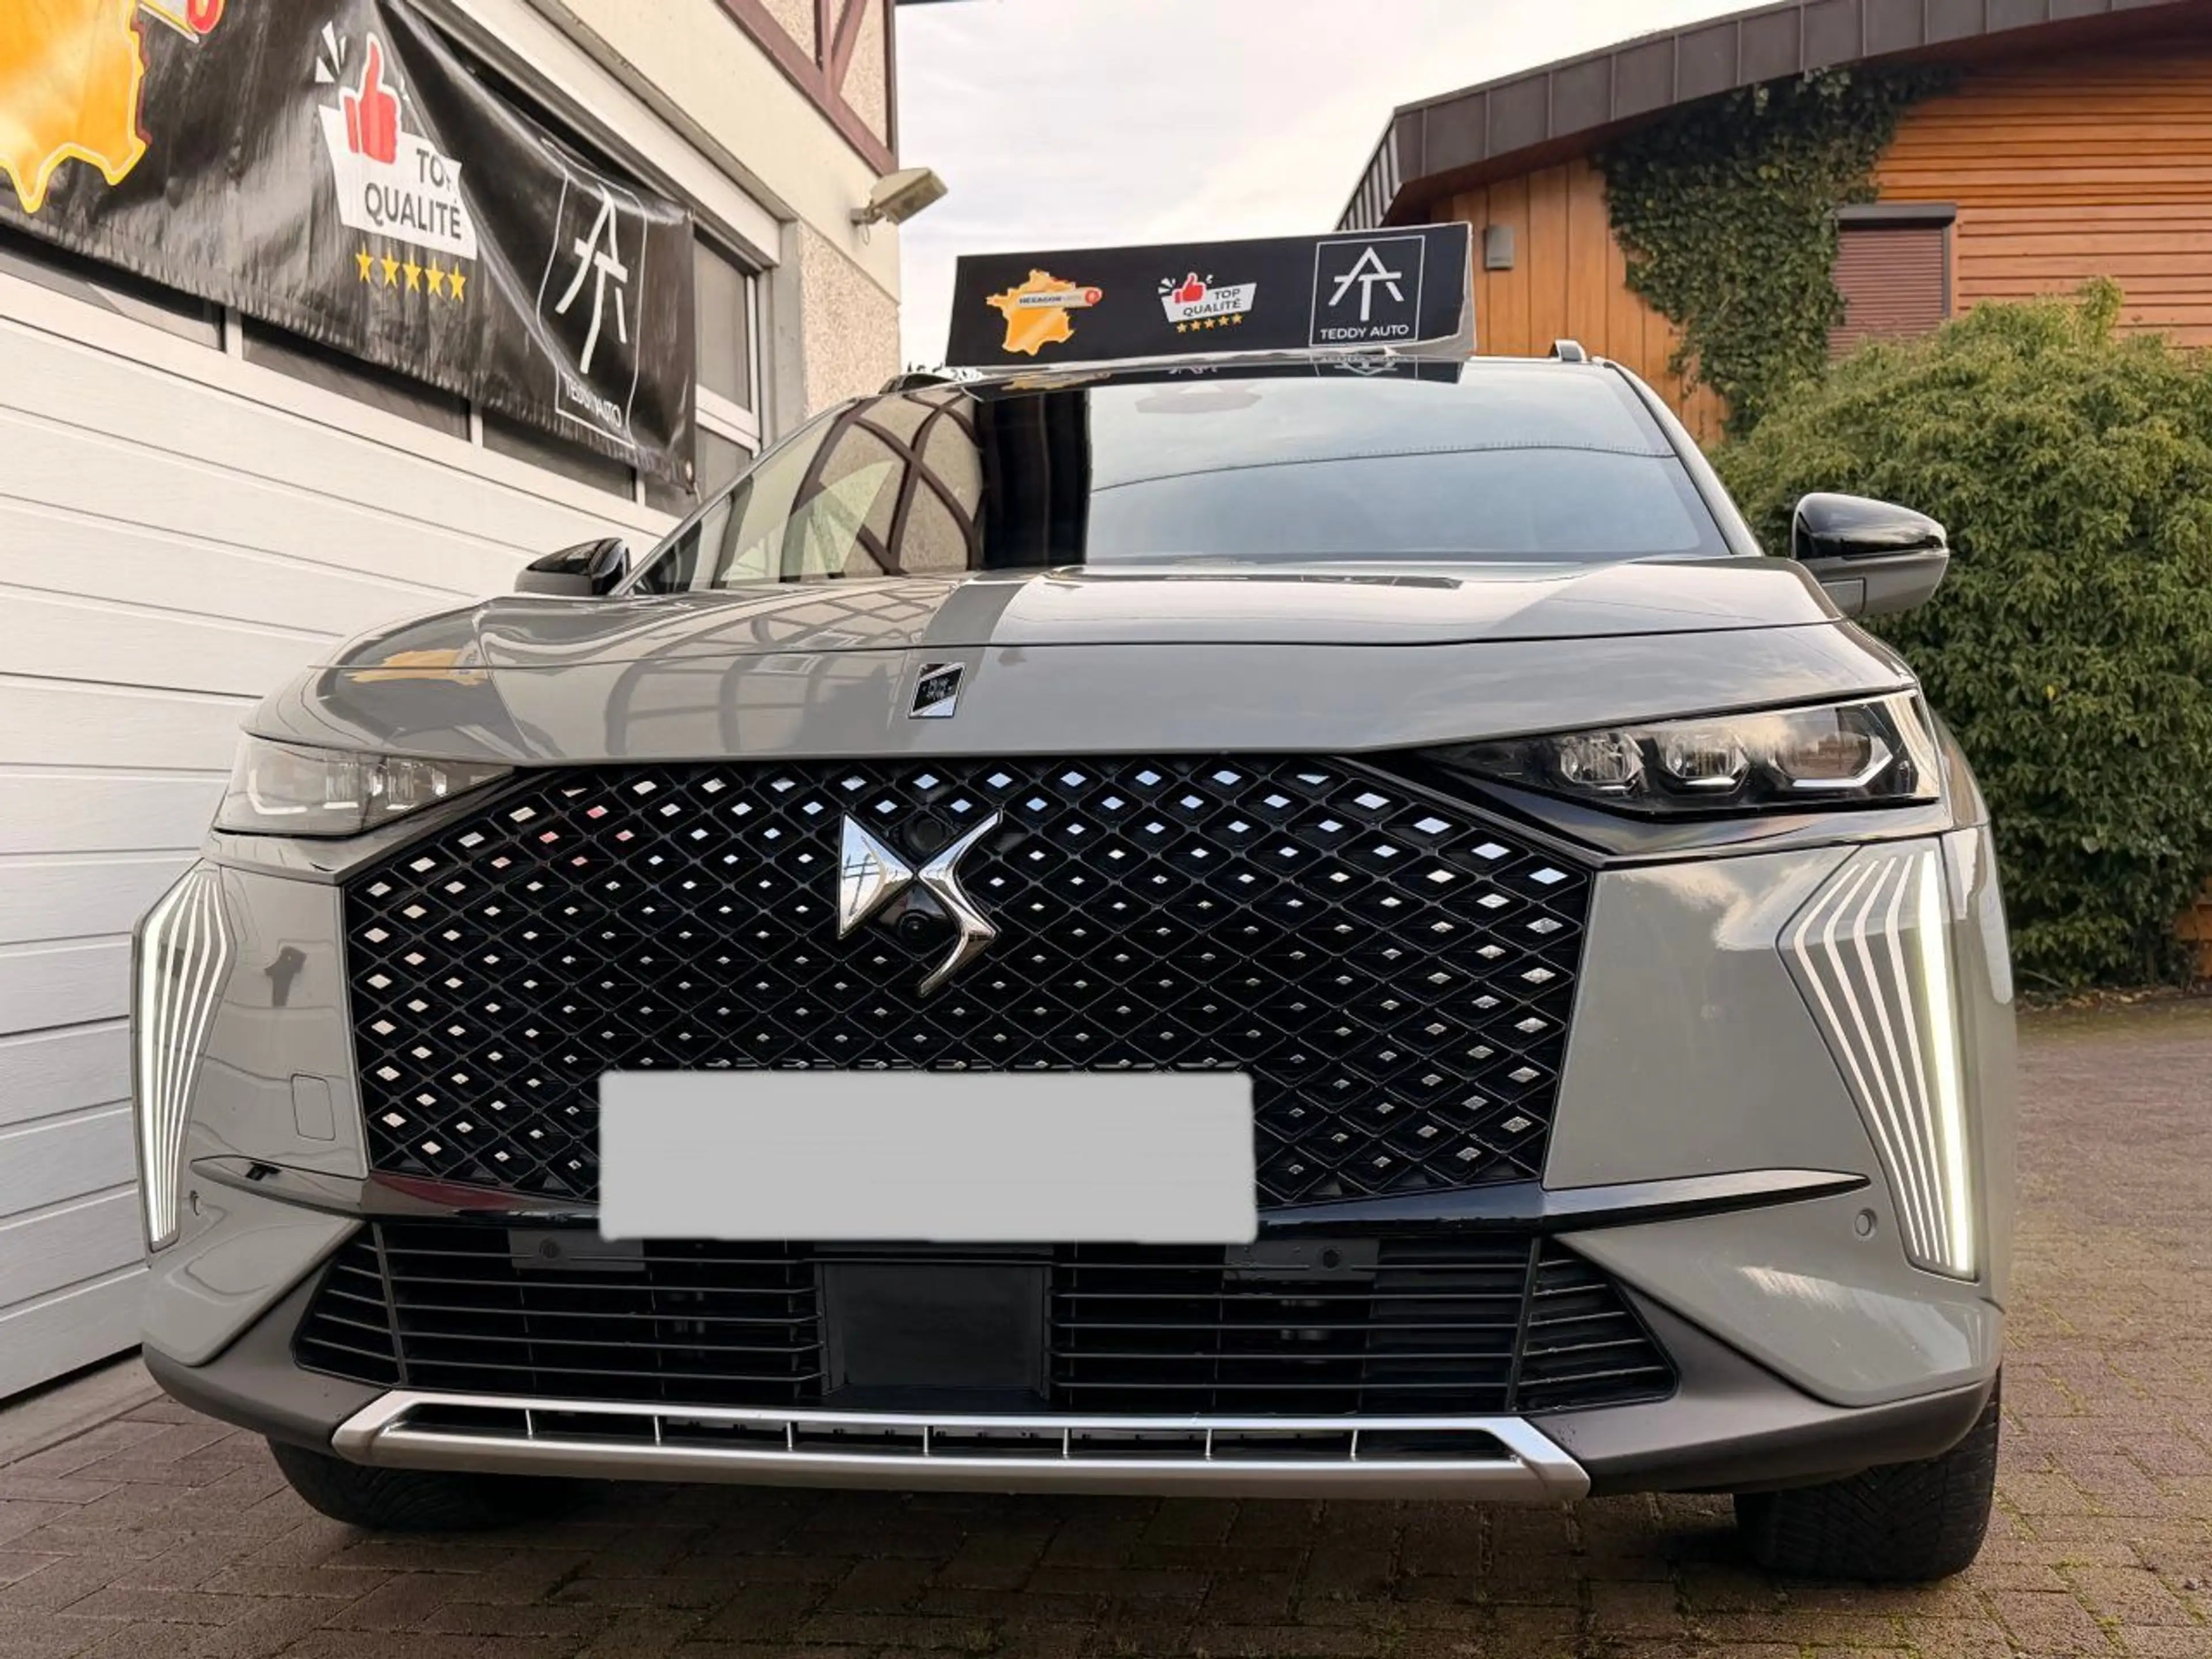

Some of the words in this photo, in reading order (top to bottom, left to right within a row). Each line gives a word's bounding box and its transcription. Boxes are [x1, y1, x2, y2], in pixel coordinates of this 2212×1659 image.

[416, 147, 450, 192] TO
[365, 182, 461, 240] QUALITÉ
[1215, 289, 1240, 300] TOP
[1183, 298, 1242, 317] QUALITÉ
[1320, 328, 1367, 340] TEDDY
[1370, 324, 1409, 337] AUTO
